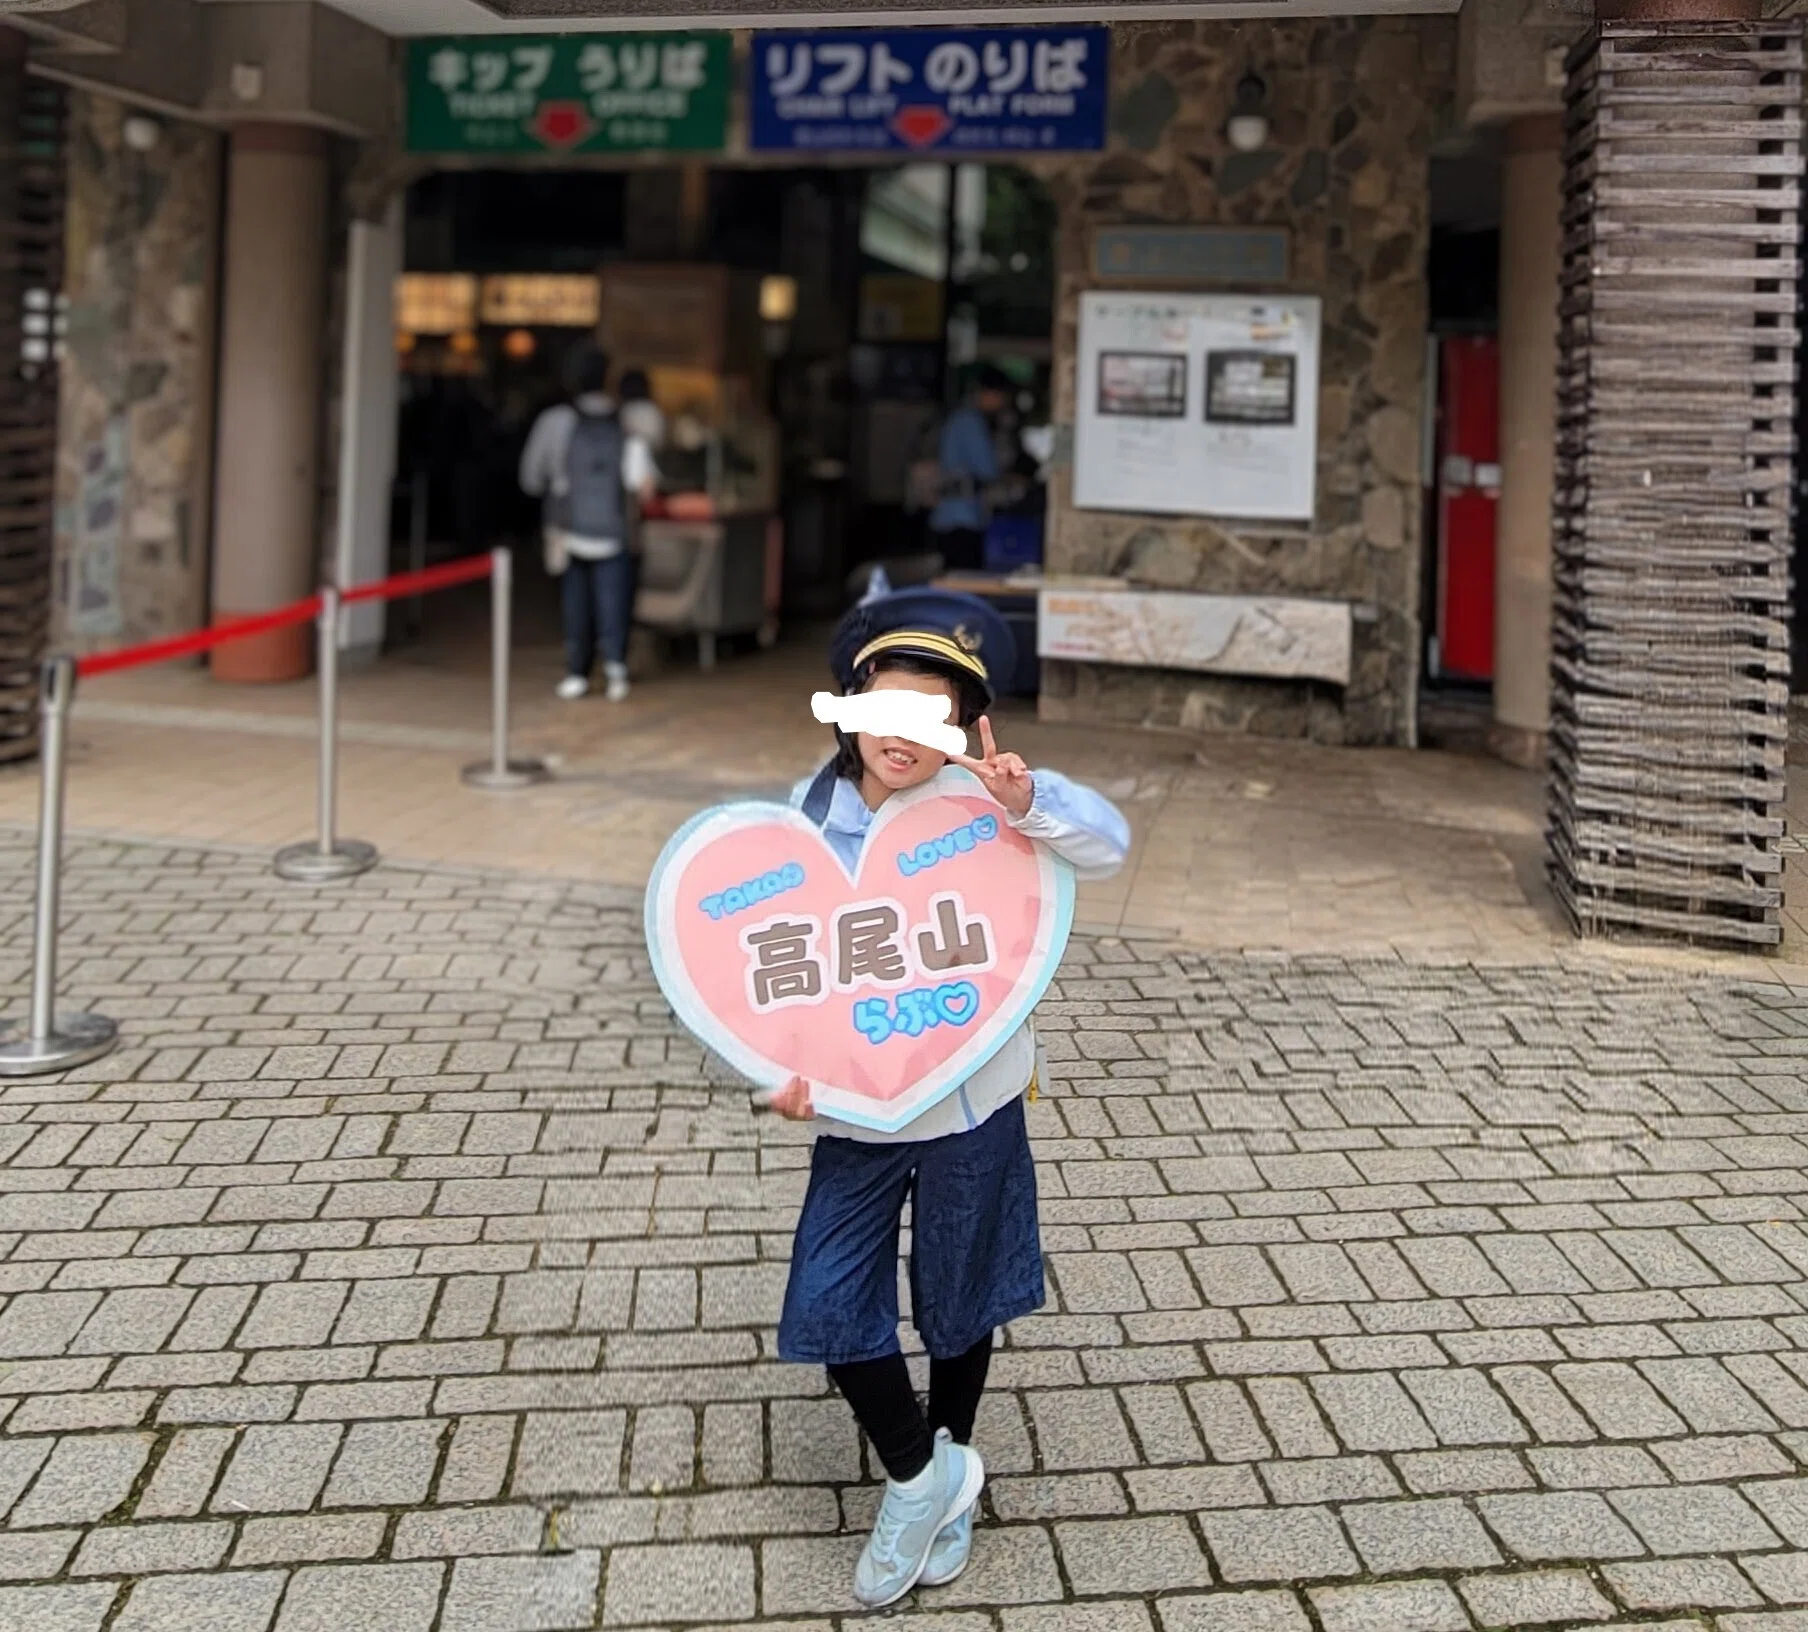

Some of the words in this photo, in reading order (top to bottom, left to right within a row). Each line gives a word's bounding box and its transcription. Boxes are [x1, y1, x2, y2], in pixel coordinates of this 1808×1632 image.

[577, 39, 707, 94] うりば
[765, 41, 913, 96] リフト
[923, 38, 1088, 94] のりば
[700, 861, 805, 919] TAKAO
[747, 899, 989, 1005] 高尾山
